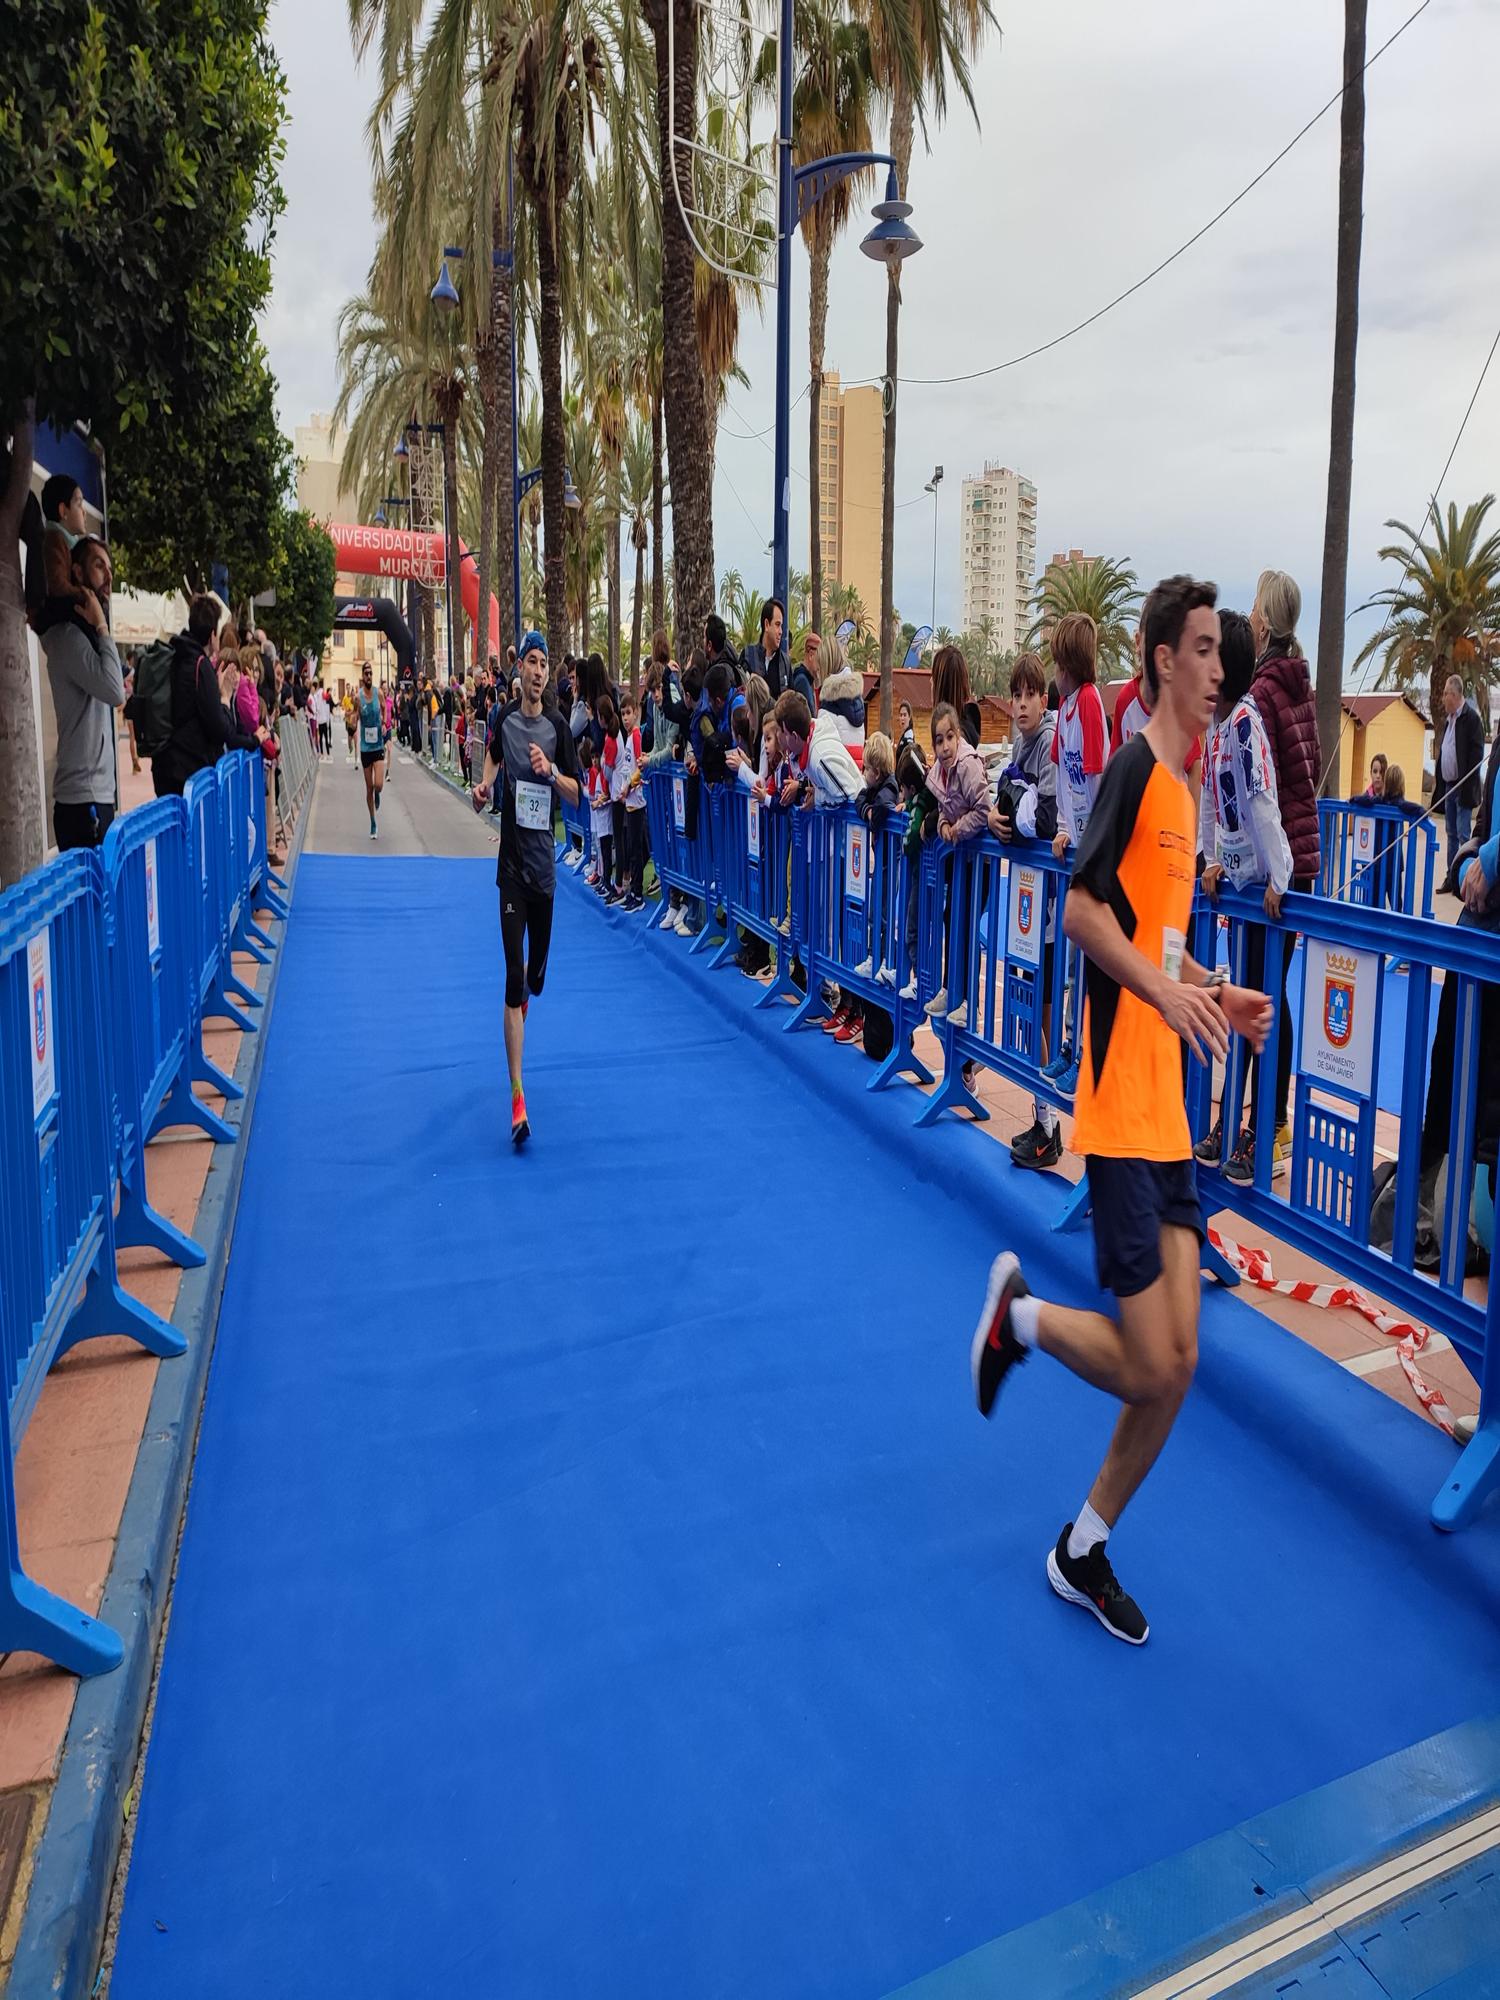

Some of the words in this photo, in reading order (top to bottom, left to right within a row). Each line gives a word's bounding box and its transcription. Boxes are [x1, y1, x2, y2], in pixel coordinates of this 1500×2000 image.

[330, 528, 411, 552] NIVERSIDAD
[416, 536, 433, 554] DE
[380, 556, 434, 578] MURCIA
[529, 799, 540, 812] 32
[1317, 1050, 1355, 1070] AYUNTAMIENTO
[1317, 1060, 1324, 1069] DE
[1325, 1062, 1336, 1072] SAN
[1336, 1067, 1353, 1080] JAVIER
